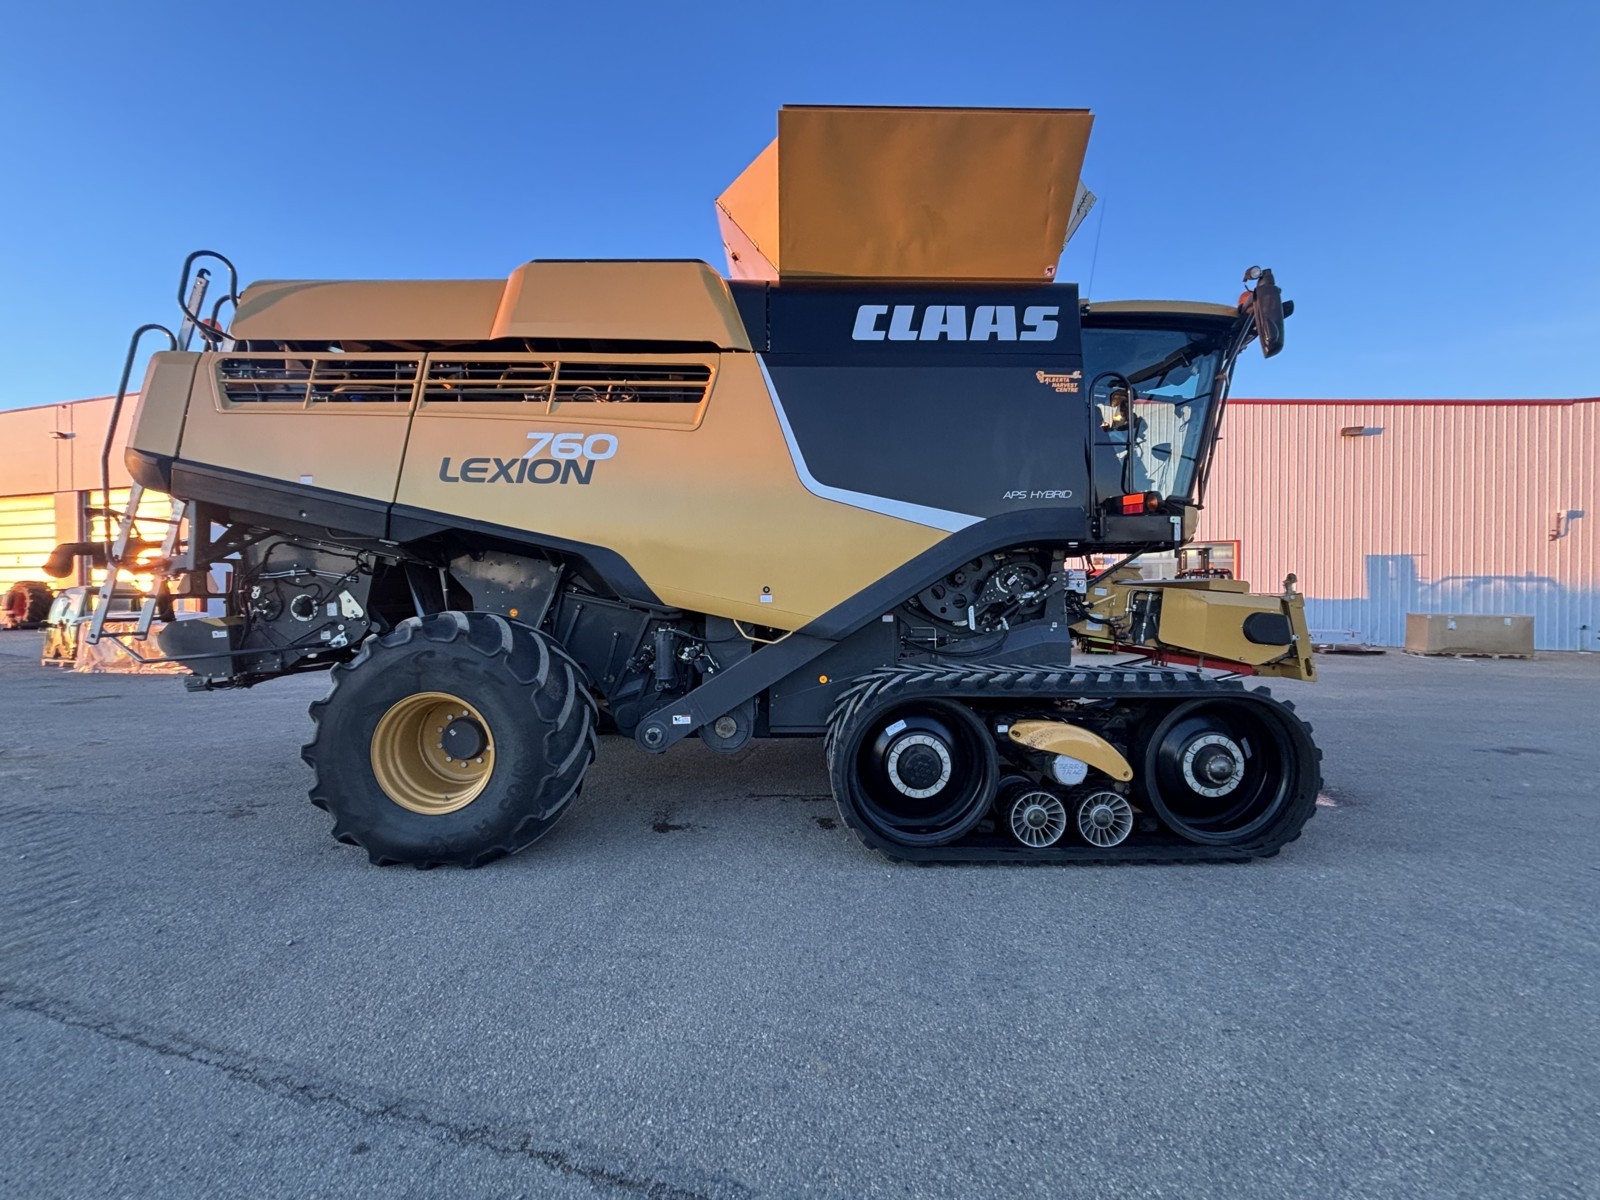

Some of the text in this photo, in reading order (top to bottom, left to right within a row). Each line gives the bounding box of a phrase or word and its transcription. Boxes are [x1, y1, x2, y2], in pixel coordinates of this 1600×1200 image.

[852, 305, 1060, 341] CLAAS
[522, 432, 619, 460] 760
[438, 457, 596, 485] LEXION
[1002, 490, 1073, 499] APS HYBRID
